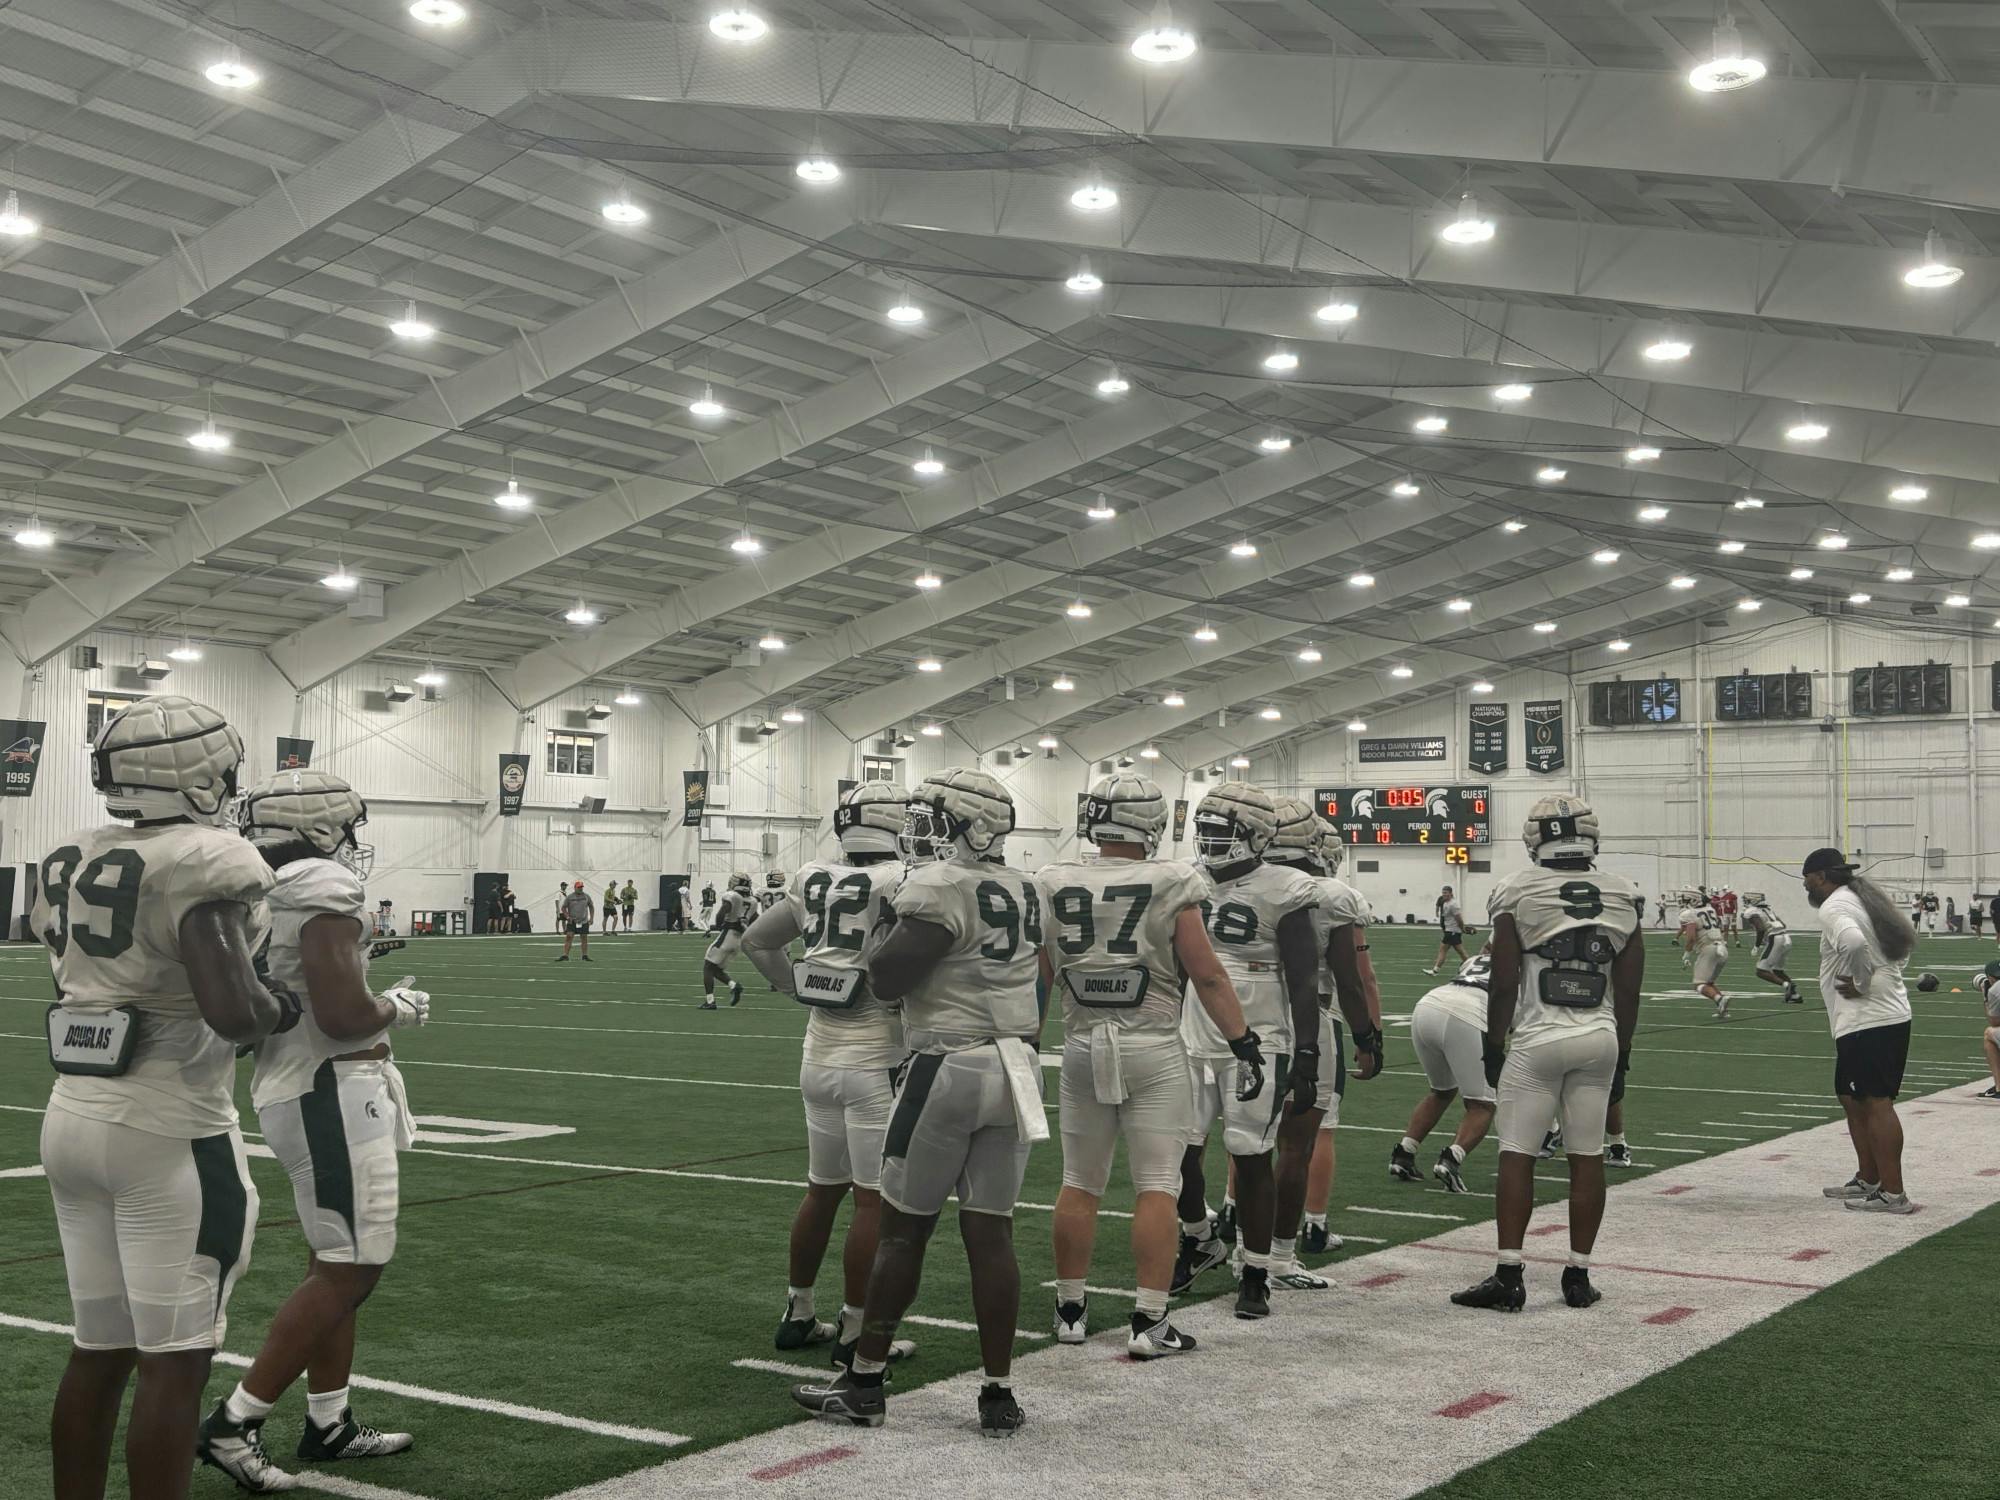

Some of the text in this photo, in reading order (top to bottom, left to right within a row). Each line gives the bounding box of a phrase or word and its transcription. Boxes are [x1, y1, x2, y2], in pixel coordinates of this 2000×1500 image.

[1361, 743, 1379, 751] GREG
[1388, 742, 1408, 750] DAWN
[1410, 741, 1444, 749] WILLIAMS
[1361, 751, 1385, 759] INDOOR
[6, 772, 31, 783] 1995
[504, 796, 520, 805] 1997
[1319, 793, 1336, 801] MSU
[1388, 790, 1422, 805] 0:05
[1461, 790, 1487, 799] GUEST
[1088, 801, 1108, 820] 97
[1328, 802, 1337, 816] 0
[1474, 800, 1484, 814] 0
[839, 808, 852, 825] 92
[1442, 822, 1455, 830] QTR
[1466, 827, 1473, 838] 3
[1550, 821, 1562, 836] 9
[1352, 831, 1357, 843] 1
[1376, 830, 1390, 844] 10
[1420, 830, 1428, 843] 2
[1449, 831, 1453, 842] 1
[1446, 847, 1468, 864] 25
[42, 846, 146, 959] 99
[804, 872, 872, 951] 92
[976, 881, 1043, 962] 94
[1053, 884, 1152, 954] 97
[1697, 910, 1720, 929] 35
[805, 974, 844, 993] DOUGLAS
[1084, 979, 1128, 993] DOUGLAS
[63, 1025, 113, 1049] DOUGLAS
